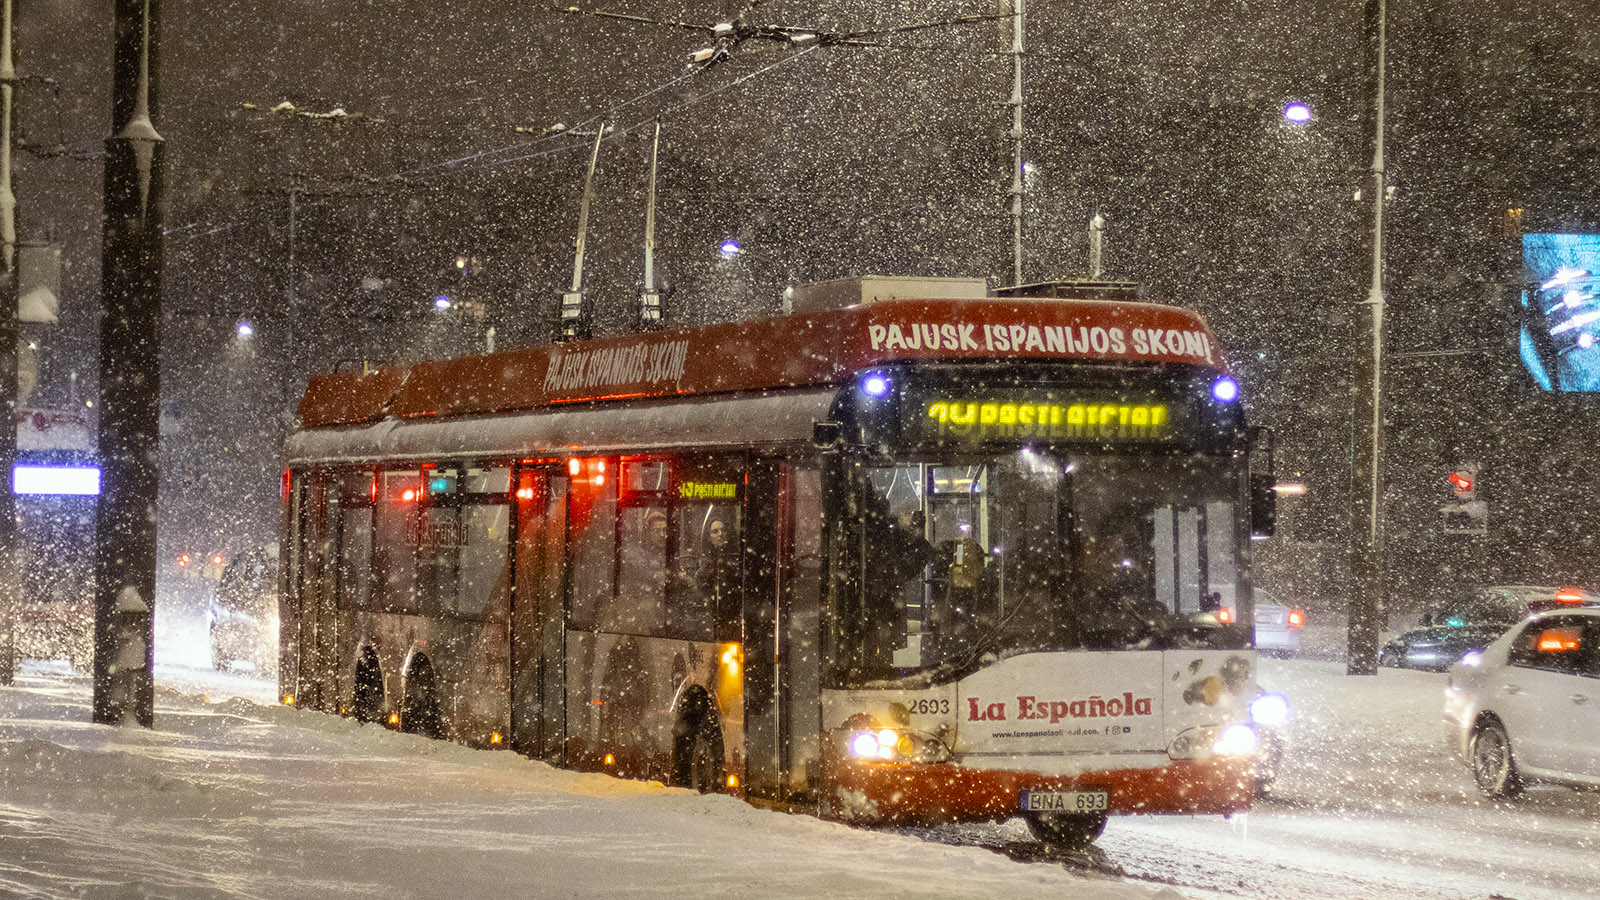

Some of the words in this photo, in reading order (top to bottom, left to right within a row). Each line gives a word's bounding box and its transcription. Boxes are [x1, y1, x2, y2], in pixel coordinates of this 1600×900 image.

[868, 324, 978, 351] PAJUSK
[984, 325, 1126, 355] ISPANIJOS
[543, 351, 589, 392] PAJUSK
[585, 341, 649, 388] ISPANIJOS
[909, 699, 950, 714] 2693
[967, 697, 1006, 722] La
[1017, 692, 1153, 724] Española
[1030, 794, 1065, 809] BNA
[1076, 794, 1105, 809] 693
